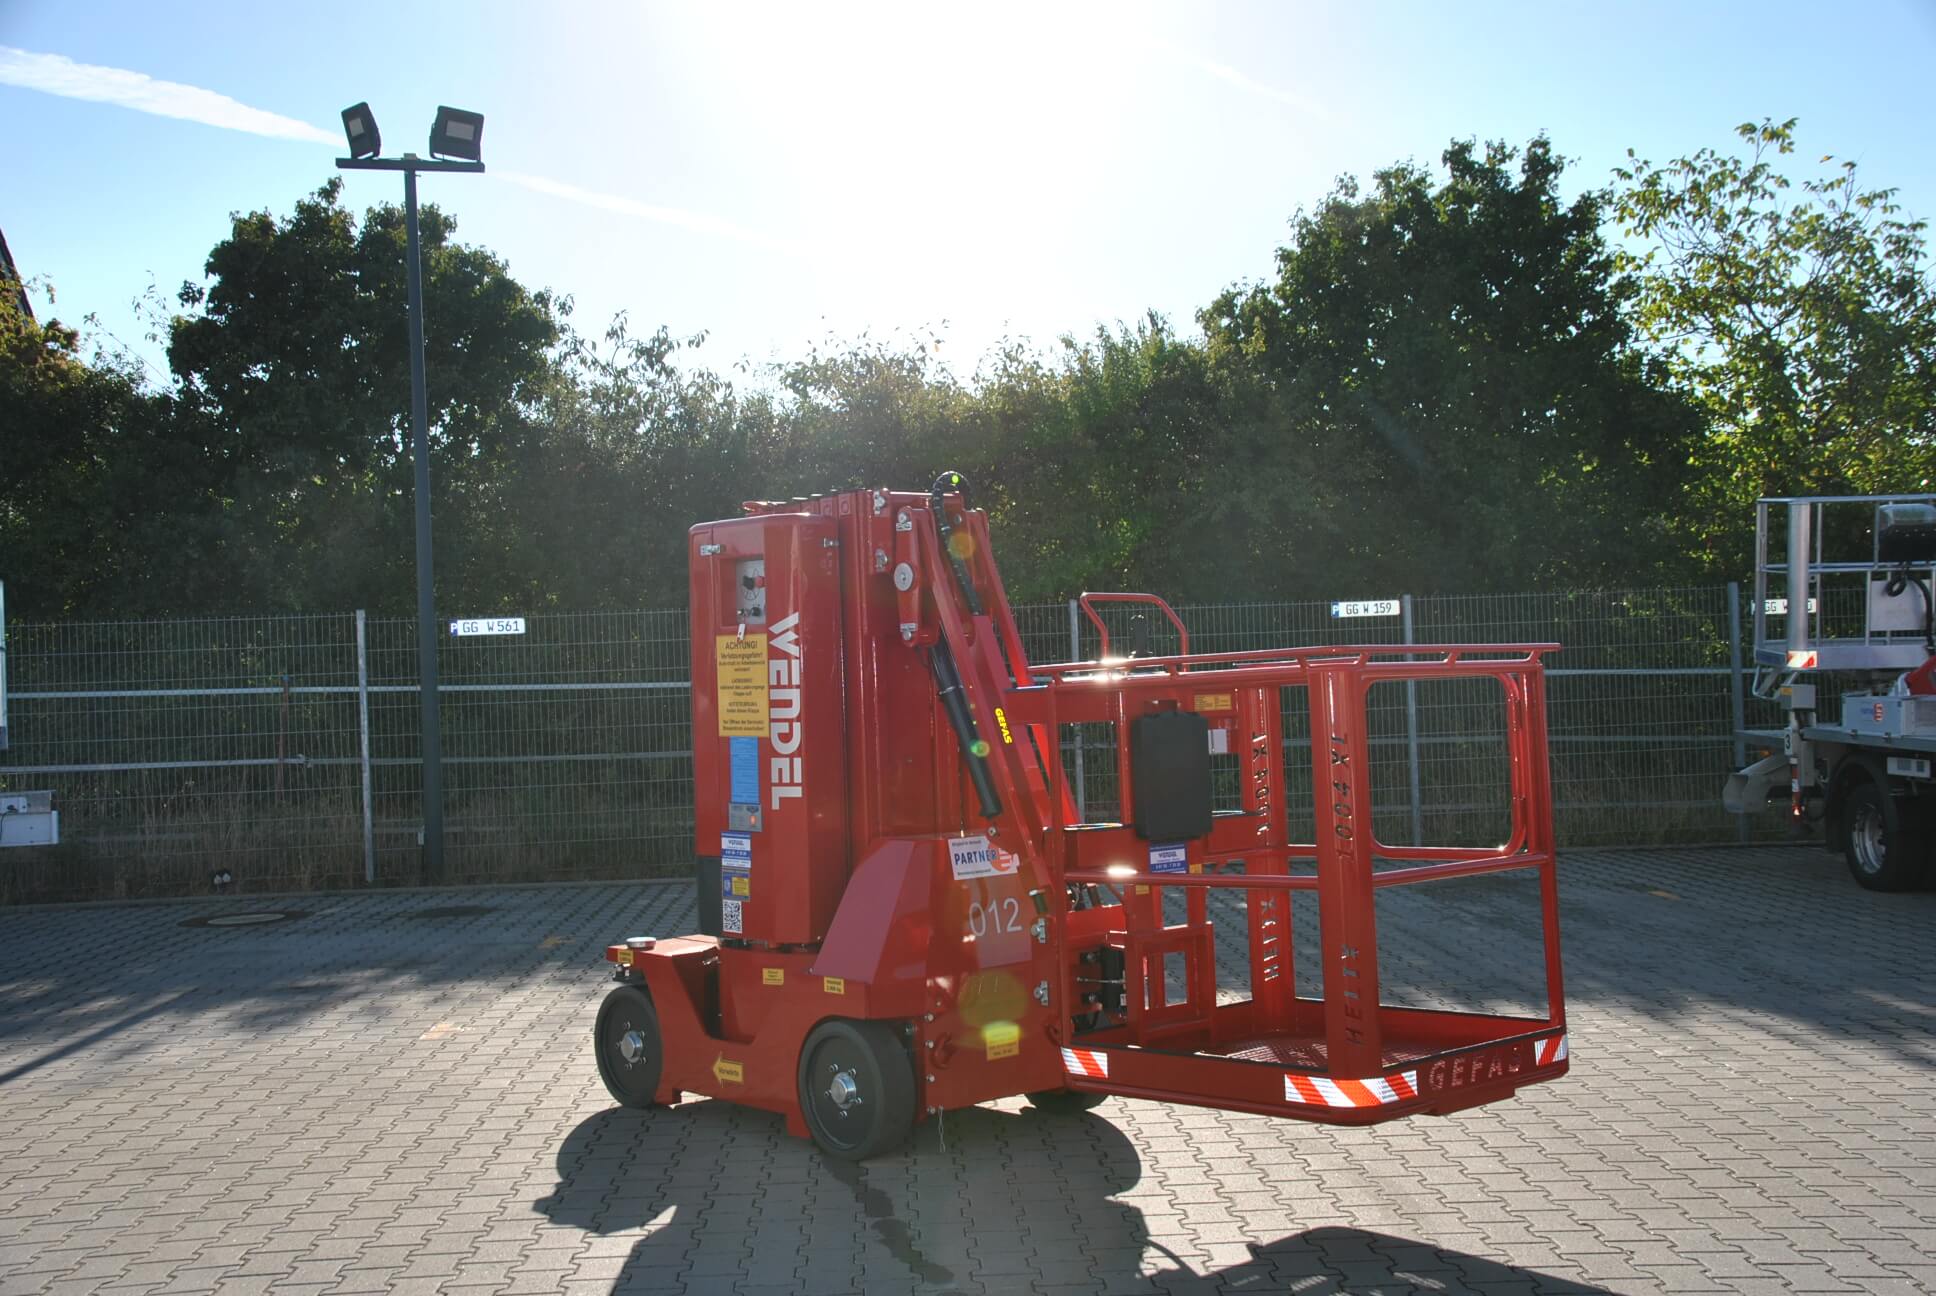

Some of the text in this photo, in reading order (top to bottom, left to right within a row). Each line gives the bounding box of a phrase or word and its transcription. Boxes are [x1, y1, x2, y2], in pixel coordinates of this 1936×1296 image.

[1345, 603, 1359, 615] GG
[1373, 602, 1392, 614] 159
[462, 621, 479, 633] GG
[725, 640, 758, 650] ACHTUNG!
[768, 611, 802, 810] WENDEL
[995, 708, 1012, 744] GEFAS
[1785, 734, 1791, 750] 3
[954, 849, 996, 865] PARTNER
[969, 898, 1023, 936] 012
[1340, 943, 1364, 1047] HELIX
